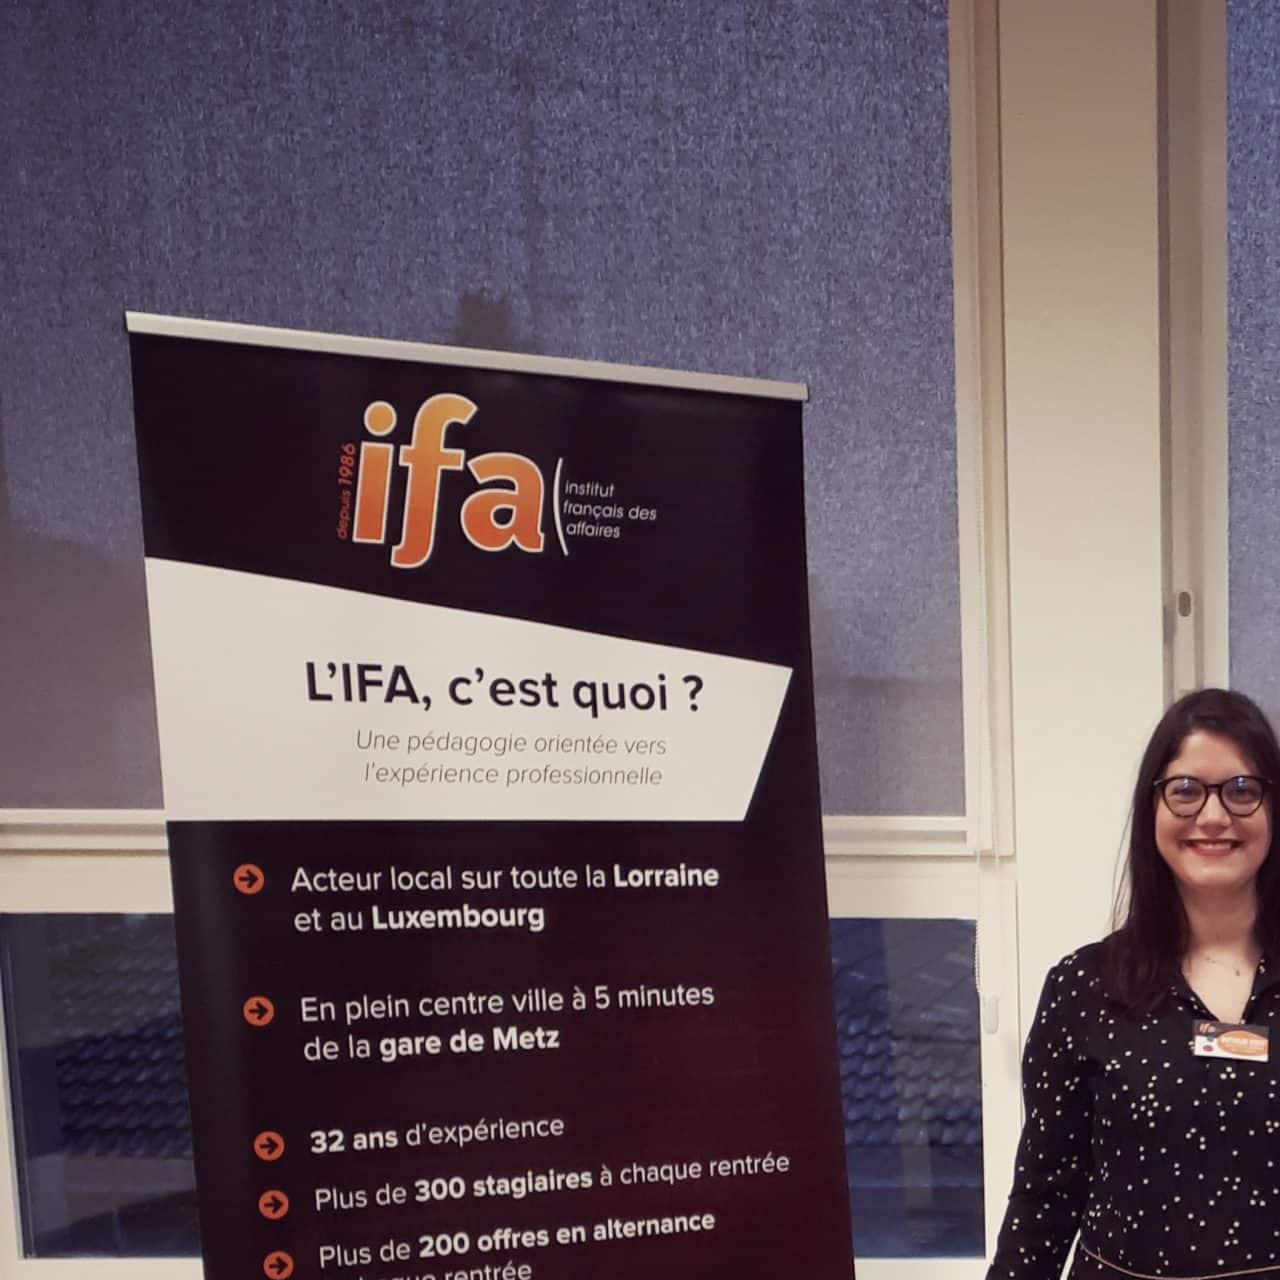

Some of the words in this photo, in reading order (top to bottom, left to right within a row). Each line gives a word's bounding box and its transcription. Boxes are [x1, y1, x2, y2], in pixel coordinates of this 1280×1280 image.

[338, 443, 356, 485] 1986
[353, 393, 544, 568] ifa
[565, 480, 614, 498] institut
[337, 490, 351, 540] depuis
[563, 500, 623, 520] français
[628, 505, 656, 520] des
[566, 522, 620, 538] affaires
[306, 661, 432, 708] L'IFA,
[449, 669, 559, 708] c'est
[573, 674, 666, 718] quoi
[683, 674, 703, 712] ?
[357, 730, 400, 751] Une
[407, 729, 527, 758] pédagogie
[534, 732, 618, 755] orientée
[625, 737, 667, 756] vers
[365, 761, 498, 786] l'expérience
[505, 763, 663, 786] professionnelle
[291, 867, 382, 893] Acteur
[391, 866, 452, 892] local
[462, 870, 503, 891] sur
[511, 866, 578, 890] toute
[585, 864, 606, 888] la
[614, 863, 720, 888] Lorraine
[294, 908, 322, 933] et
[331, 911, 363, 932] au
[372, 904, 545, 934] Luxembourg
[301, 997, 337, 1024] En
[345, 993, 410, 1027] plein
[419, 992, 504, 1018] centre
[512, 988, 564, 1014] ville
[572, 986, 587, 1010] à
[595, 986, 610, 1010] 5
[618, 983, 715, 1009] minutes
[303, 1036, 339, 1061] de
[348, 1035, 371, 1060] la
[379, 1031, 441, 1063] gare
[450, 1029, 484, 1055] de
[493, 1027, 560, 1052] Metz
[310, 1129, 345, 1154] 32
[353, 1128, 398, 1151] ans
[406, 1116, 565, 1149] d'expérience
[315, 1186, 367, 1212] Plus
[375, 1182, 406, 1206] de
[415, 1178, 465, 1203] 300
[473, 1169, 592, 1202] stagiaires
[600, 1164, 613, 1187] à
[620, 1160, 702, 1188] chaque
[709, 1152, 790, 1178] rentrée
[319, 1243, 371, 1269] Plus
[379, 1238, 411, 1264] de
[419, 1232, 469, 1258] 200
[478, 1226, 549, 1253] offres
[556, 1224, 586, 1246] en
[593, 1211, 715, 1242] alternance
